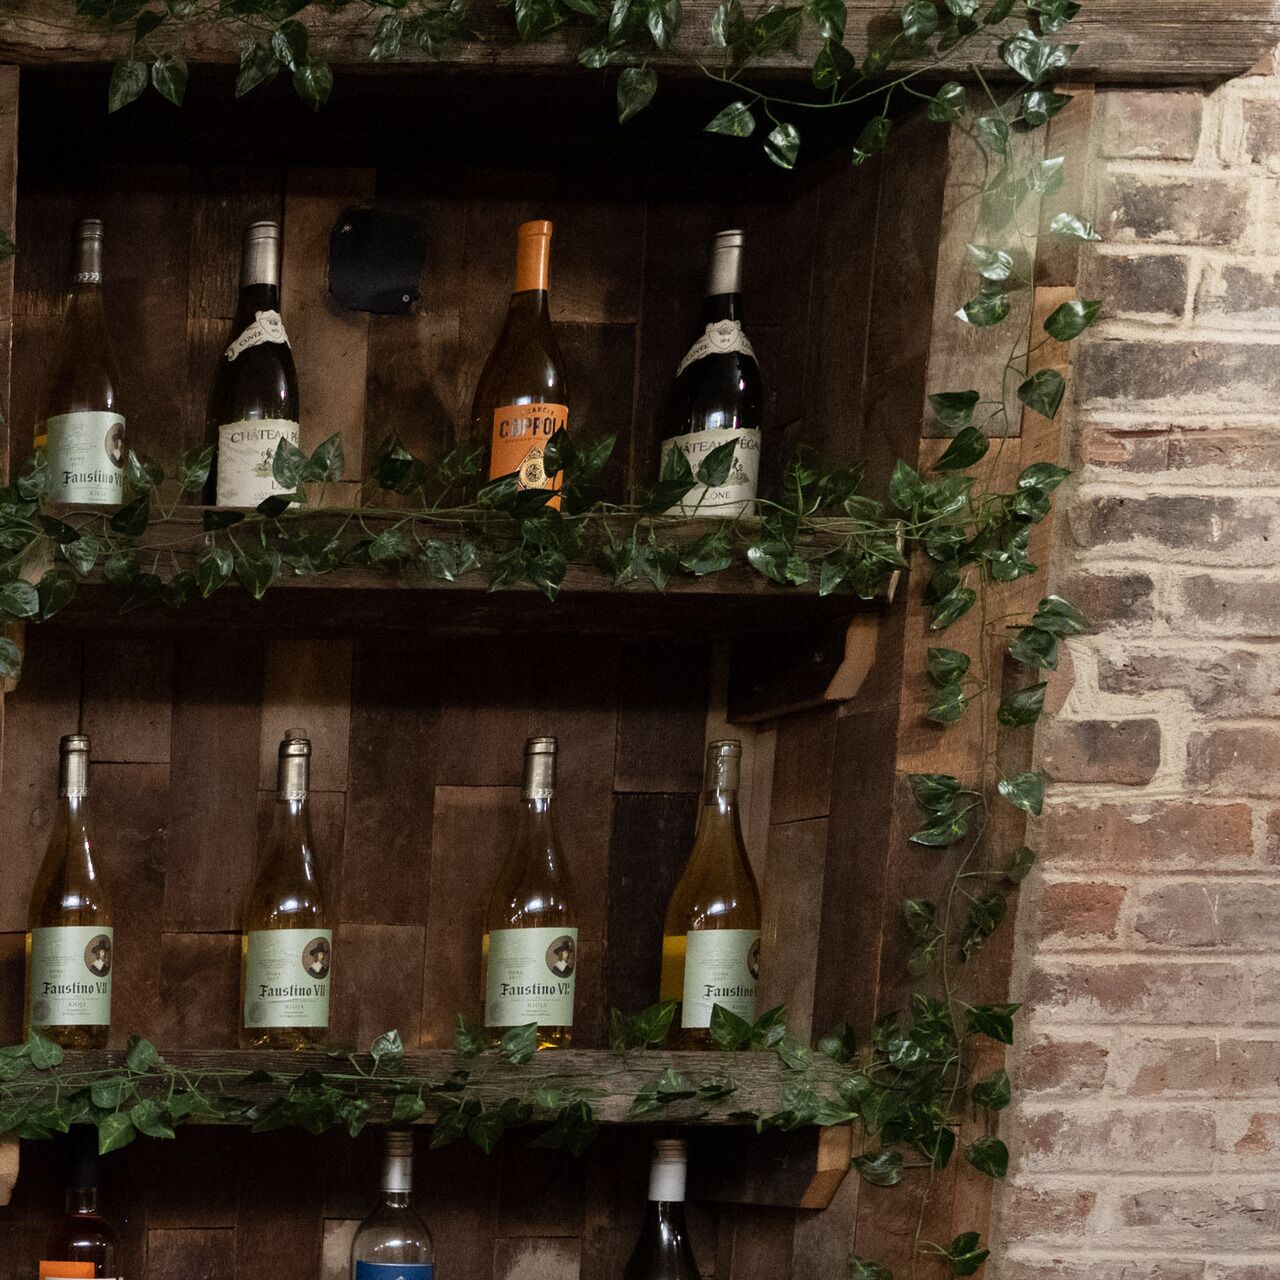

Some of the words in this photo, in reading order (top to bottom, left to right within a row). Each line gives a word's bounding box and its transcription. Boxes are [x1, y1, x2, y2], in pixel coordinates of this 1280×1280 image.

[62, 470, 114, 488] Faustino
[41, 981, 94, 998] Faustino
[258, 984, 312, 1000] Faustino
[499, 982, 556, 999] Faustino
